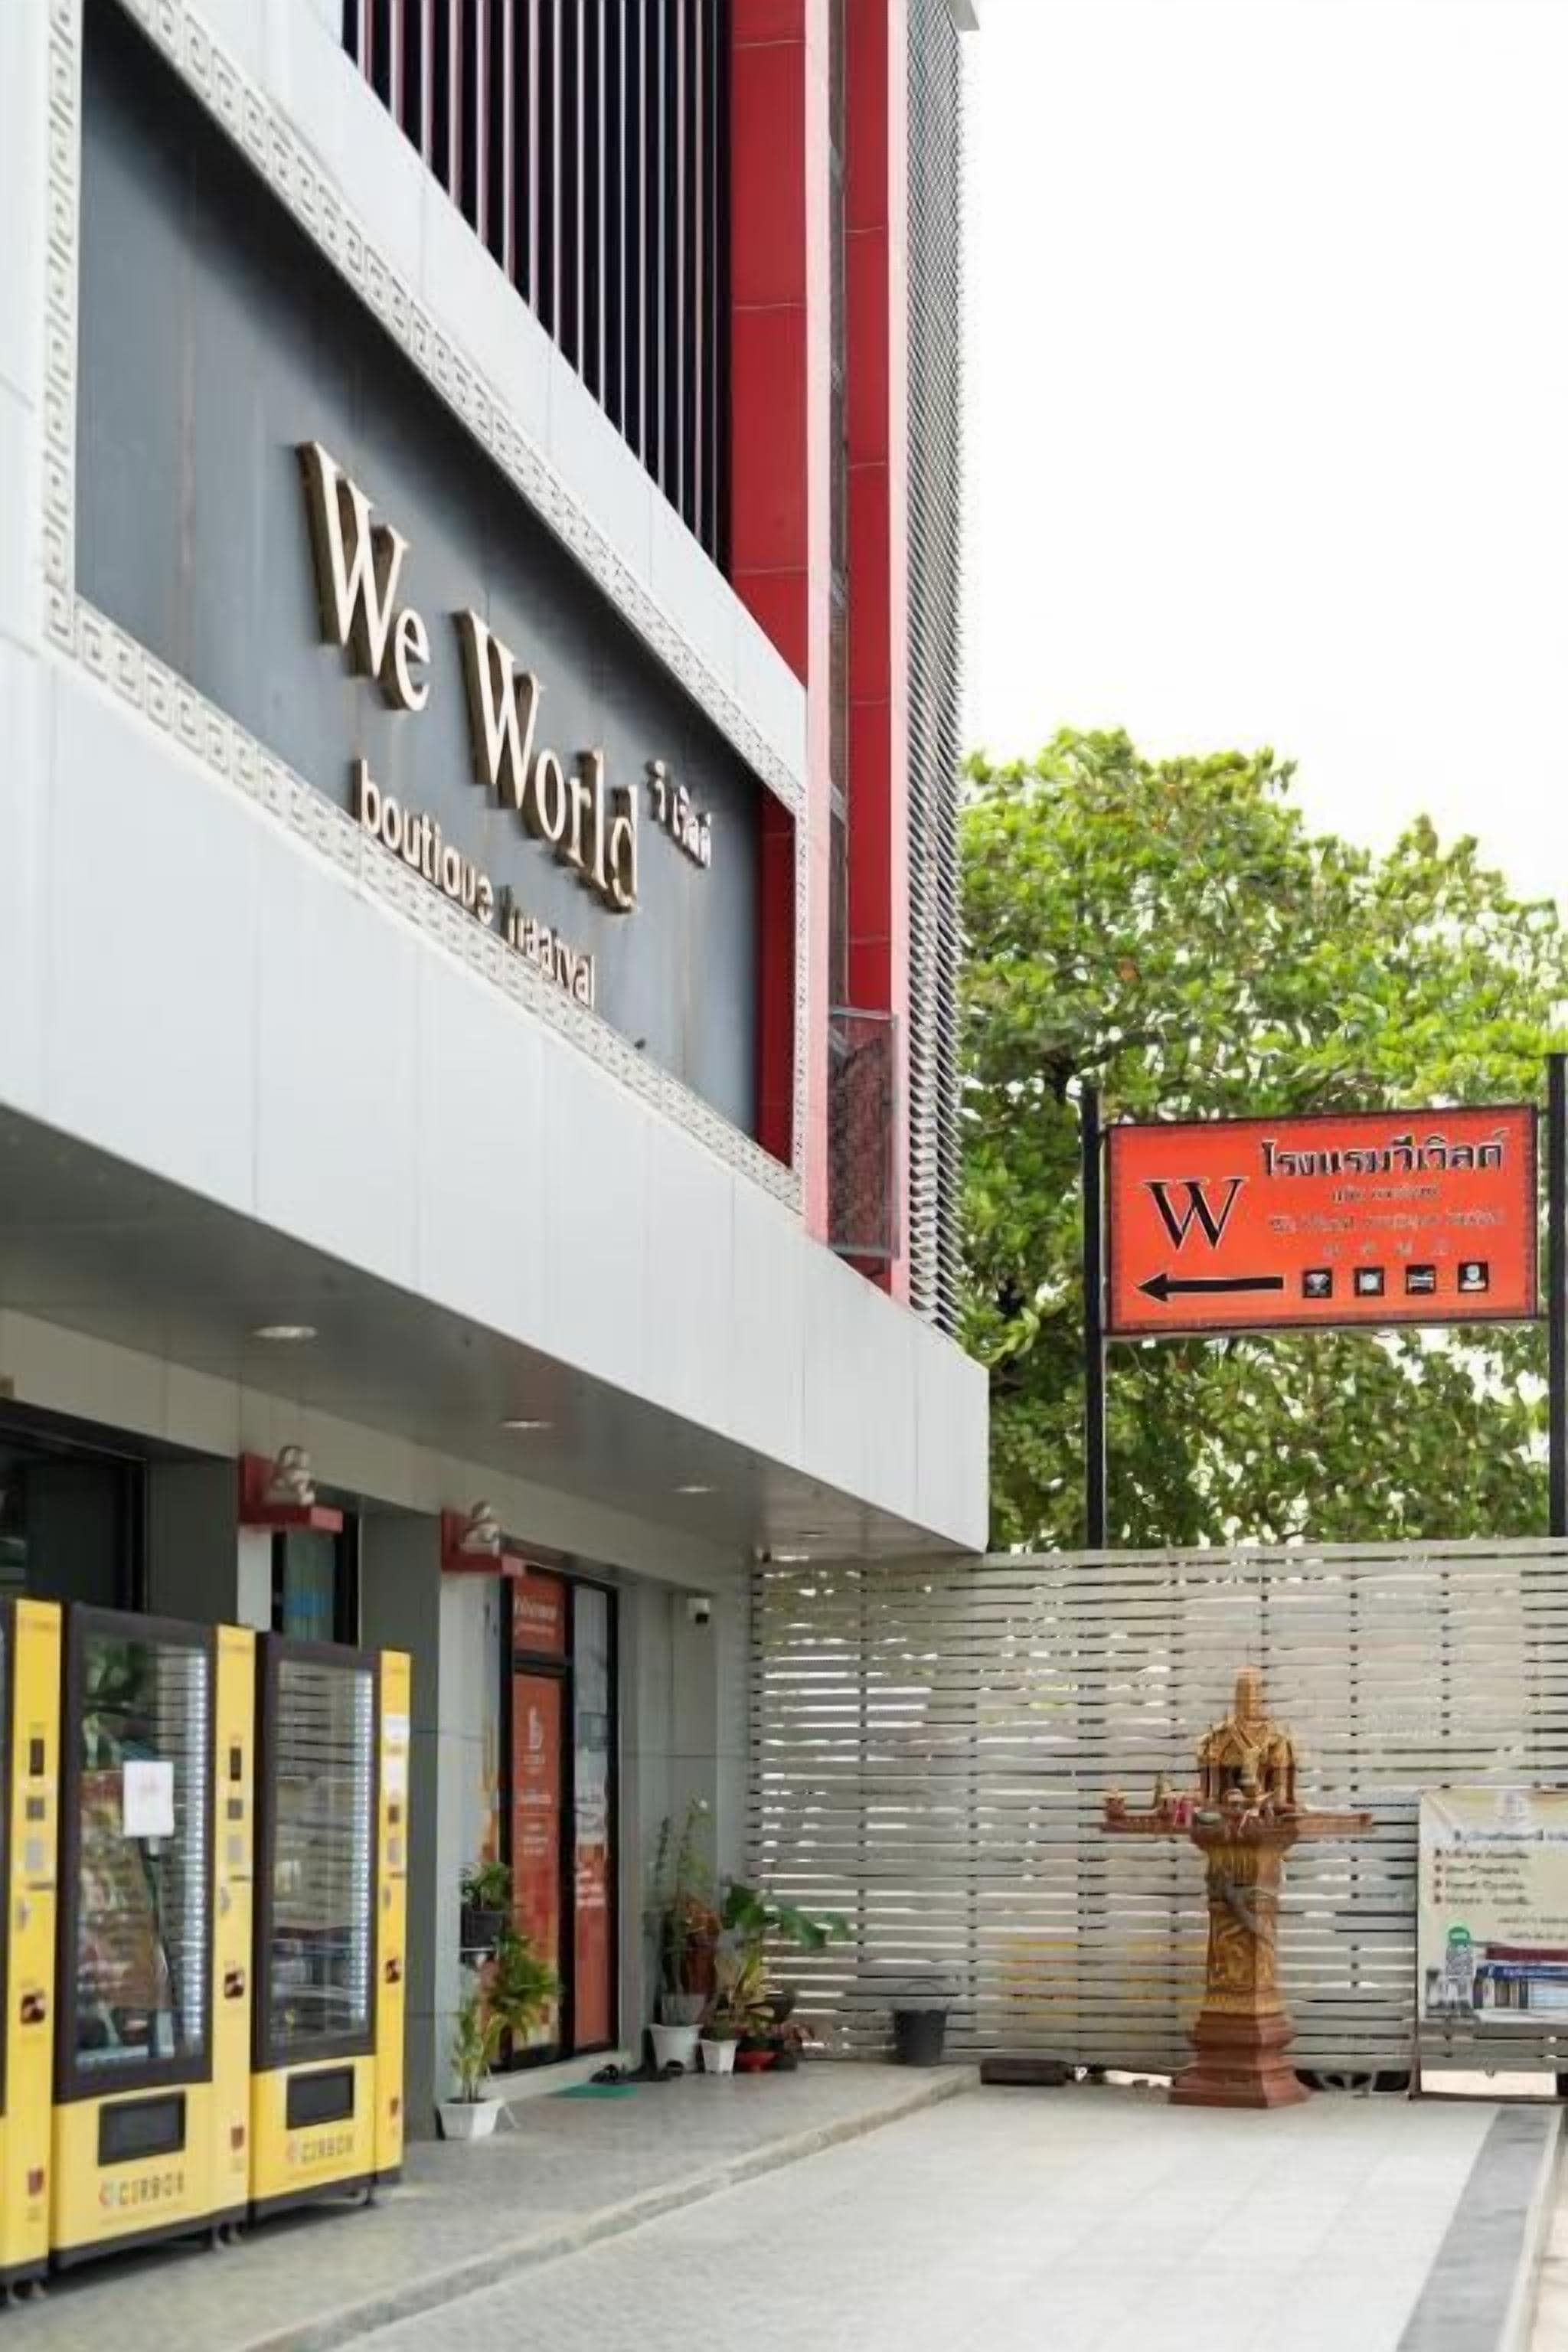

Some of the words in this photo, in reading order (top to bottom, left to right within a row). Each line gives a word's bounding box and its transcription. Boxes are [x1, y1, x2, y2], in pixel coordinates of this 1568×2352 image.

[297, 439, 430, 712] We
[458, 609, 640, 911] World
[1147, 1178, 1247, 1250] W
